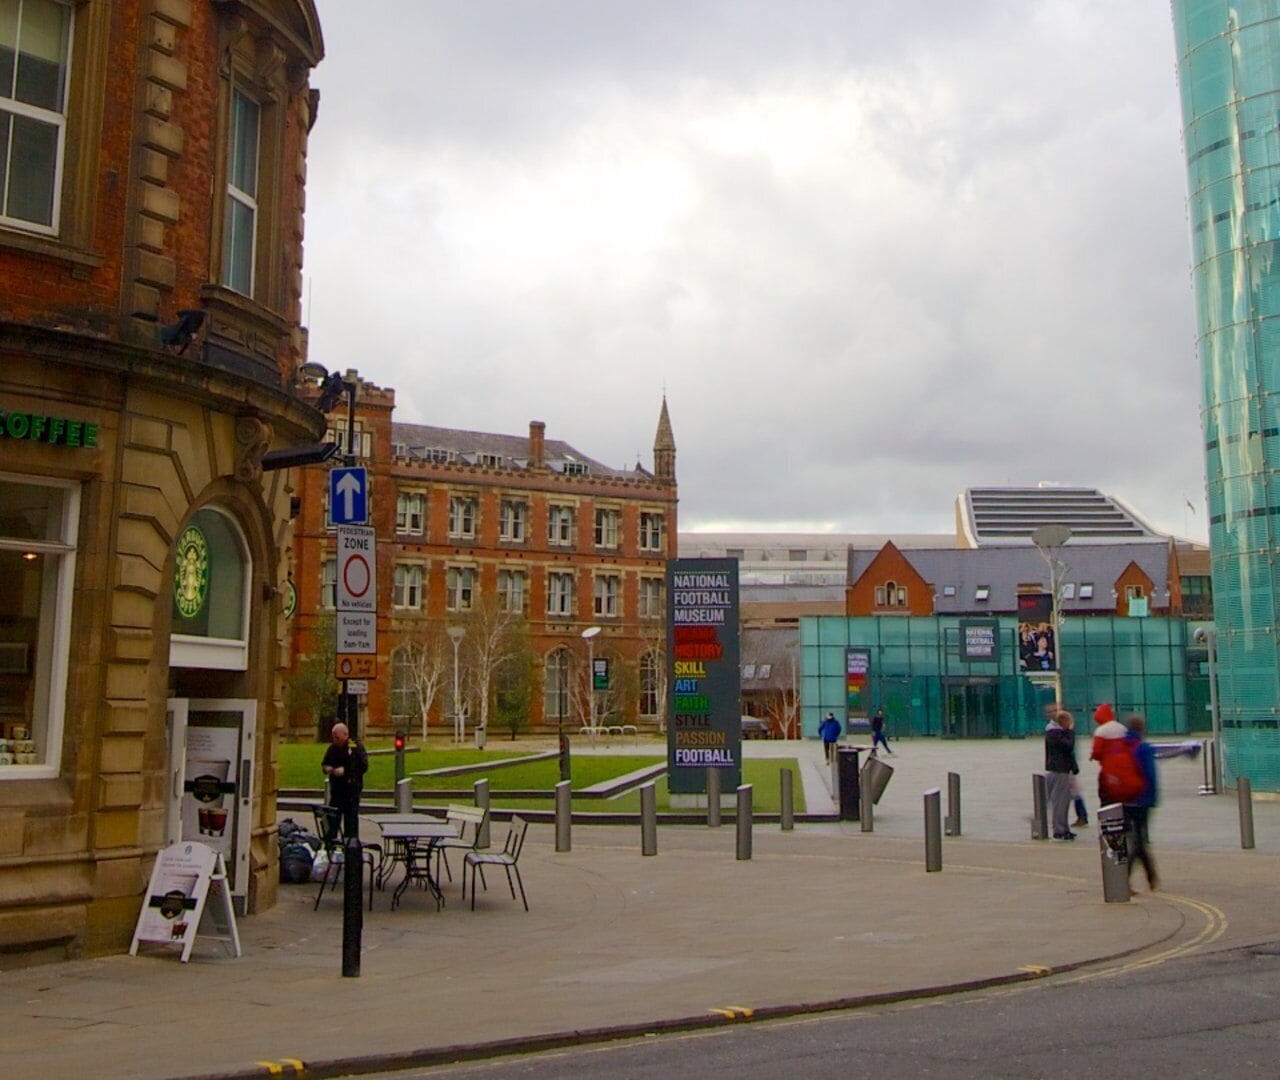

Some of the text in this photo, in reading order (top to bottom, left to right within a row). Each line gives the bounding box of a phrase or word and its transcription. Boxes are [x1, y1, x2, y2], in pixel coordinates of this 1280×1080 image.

[339, 527, 374, 536] PEDESTRIAN
[344, 537, 369, 550] ZONE
[674, 575, 730, 587] NATIONAL
[674, 592, 731, 605] FOOTBALL
[674, 609, 725, 622] MUSEUM
[674, 644, 723, 658] HISTORY
[674, 661, 706, 674] SKILL
[675, 679, 697, 692] ART
[675, 696, 709, 709] FAITH
[675, 714, 710, 727] STYLE
[676, 731, 725, 745] PASSION
[676, 749, 734, 762] FOOTBALL
